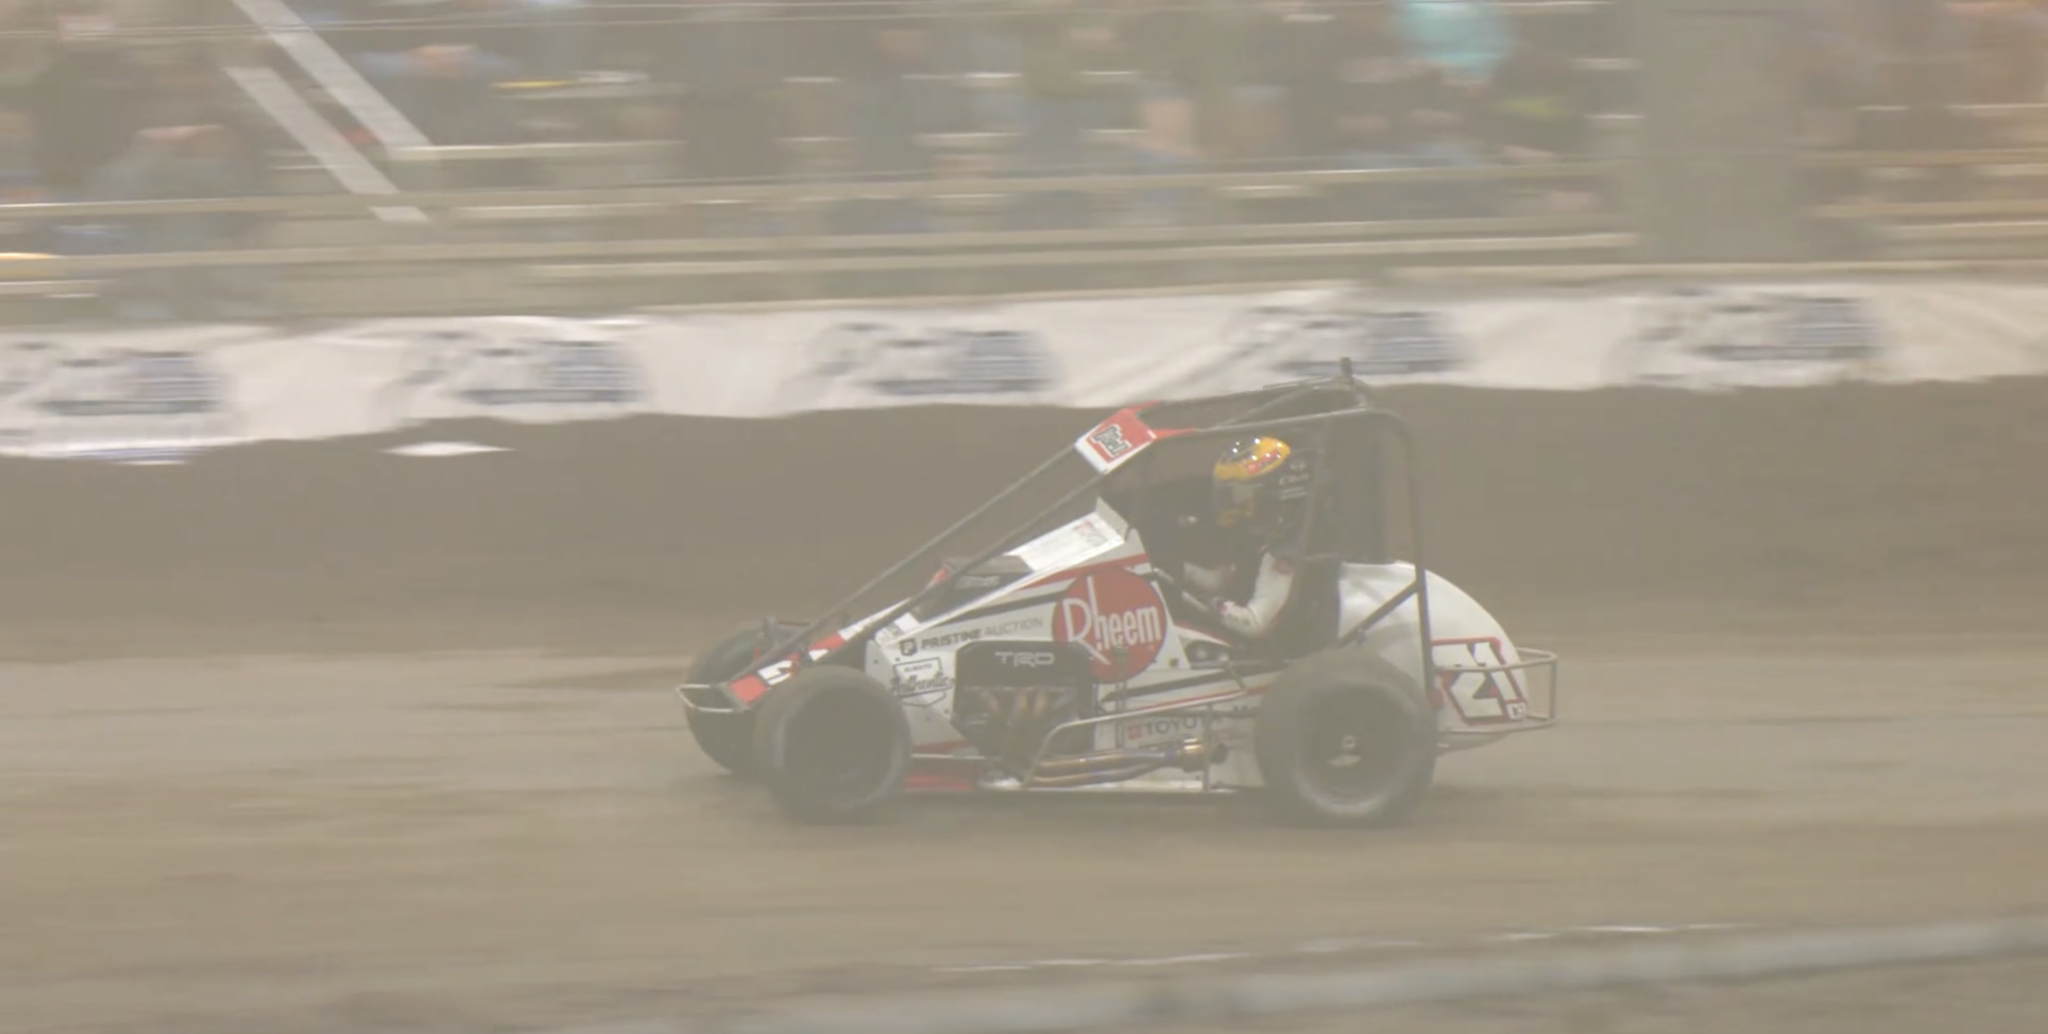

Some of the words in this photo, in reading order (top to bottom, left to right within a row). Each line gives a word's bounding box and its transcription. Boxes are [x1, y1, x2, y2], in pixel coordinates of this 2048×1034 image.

[921, 628, 982, 650] PRISTINE
[984, 616, 1044, 639] AUCTION
[1062, 575, 1162, 666] Rheem
[994, 652, 1055, 667] TRD
